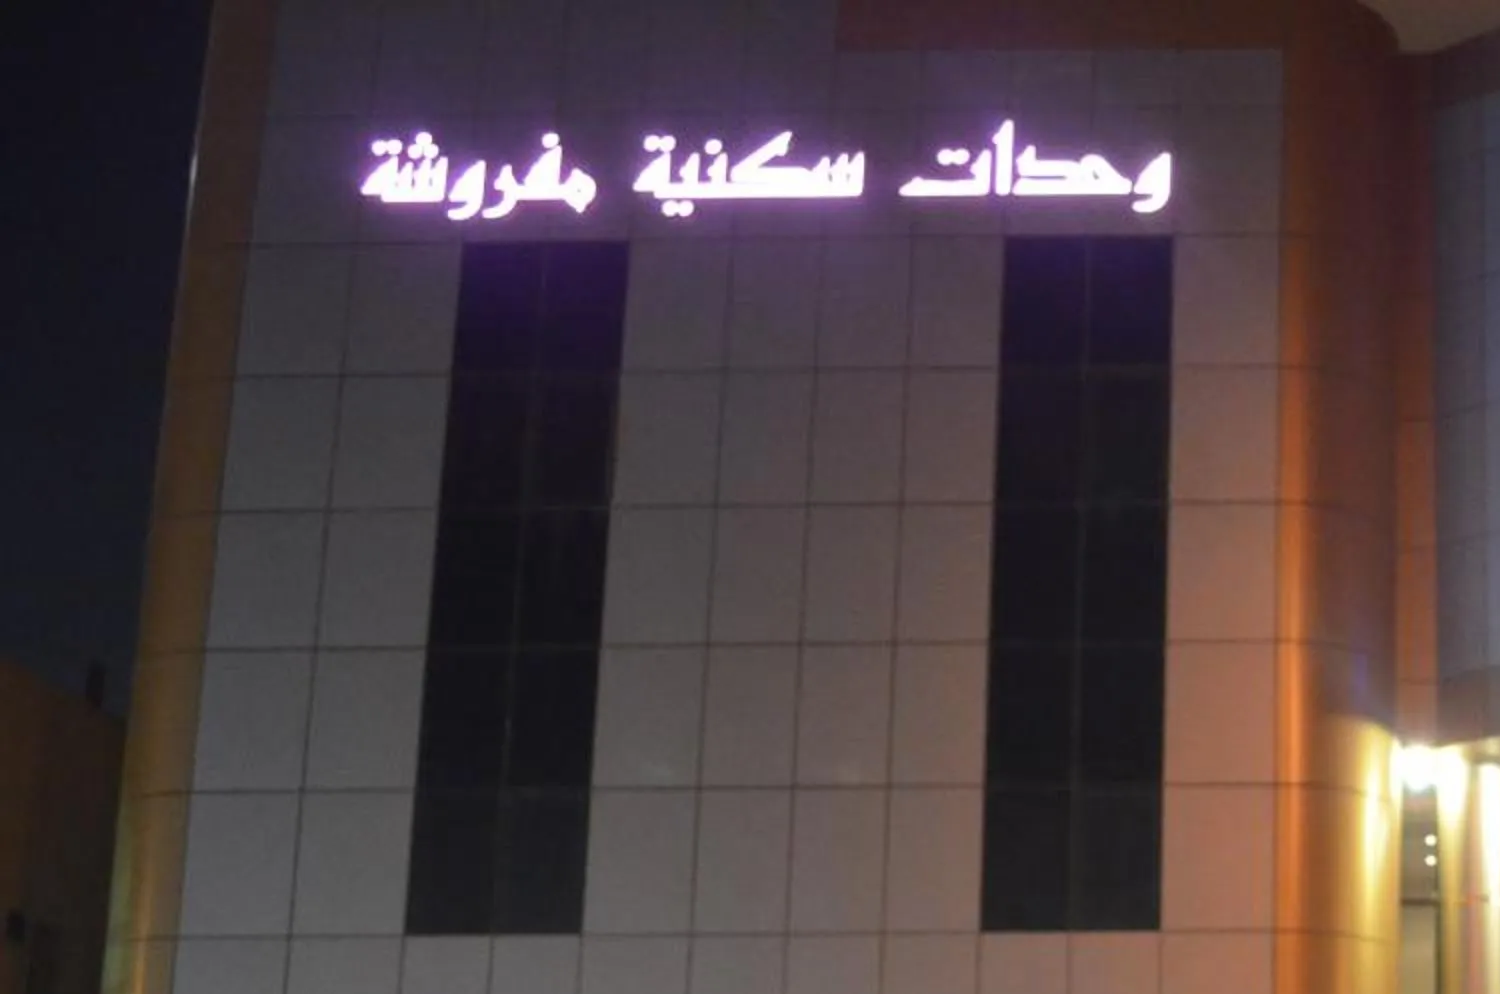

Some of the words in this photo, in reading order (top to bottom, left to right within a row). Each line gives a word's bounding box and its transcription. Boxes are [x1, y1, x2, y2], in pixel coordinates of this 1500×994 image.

[359, 131, 597, 220] مفروشة
[631, 130, 866, 217] سكنية
[898, 118, 1173, 213] وحدات
